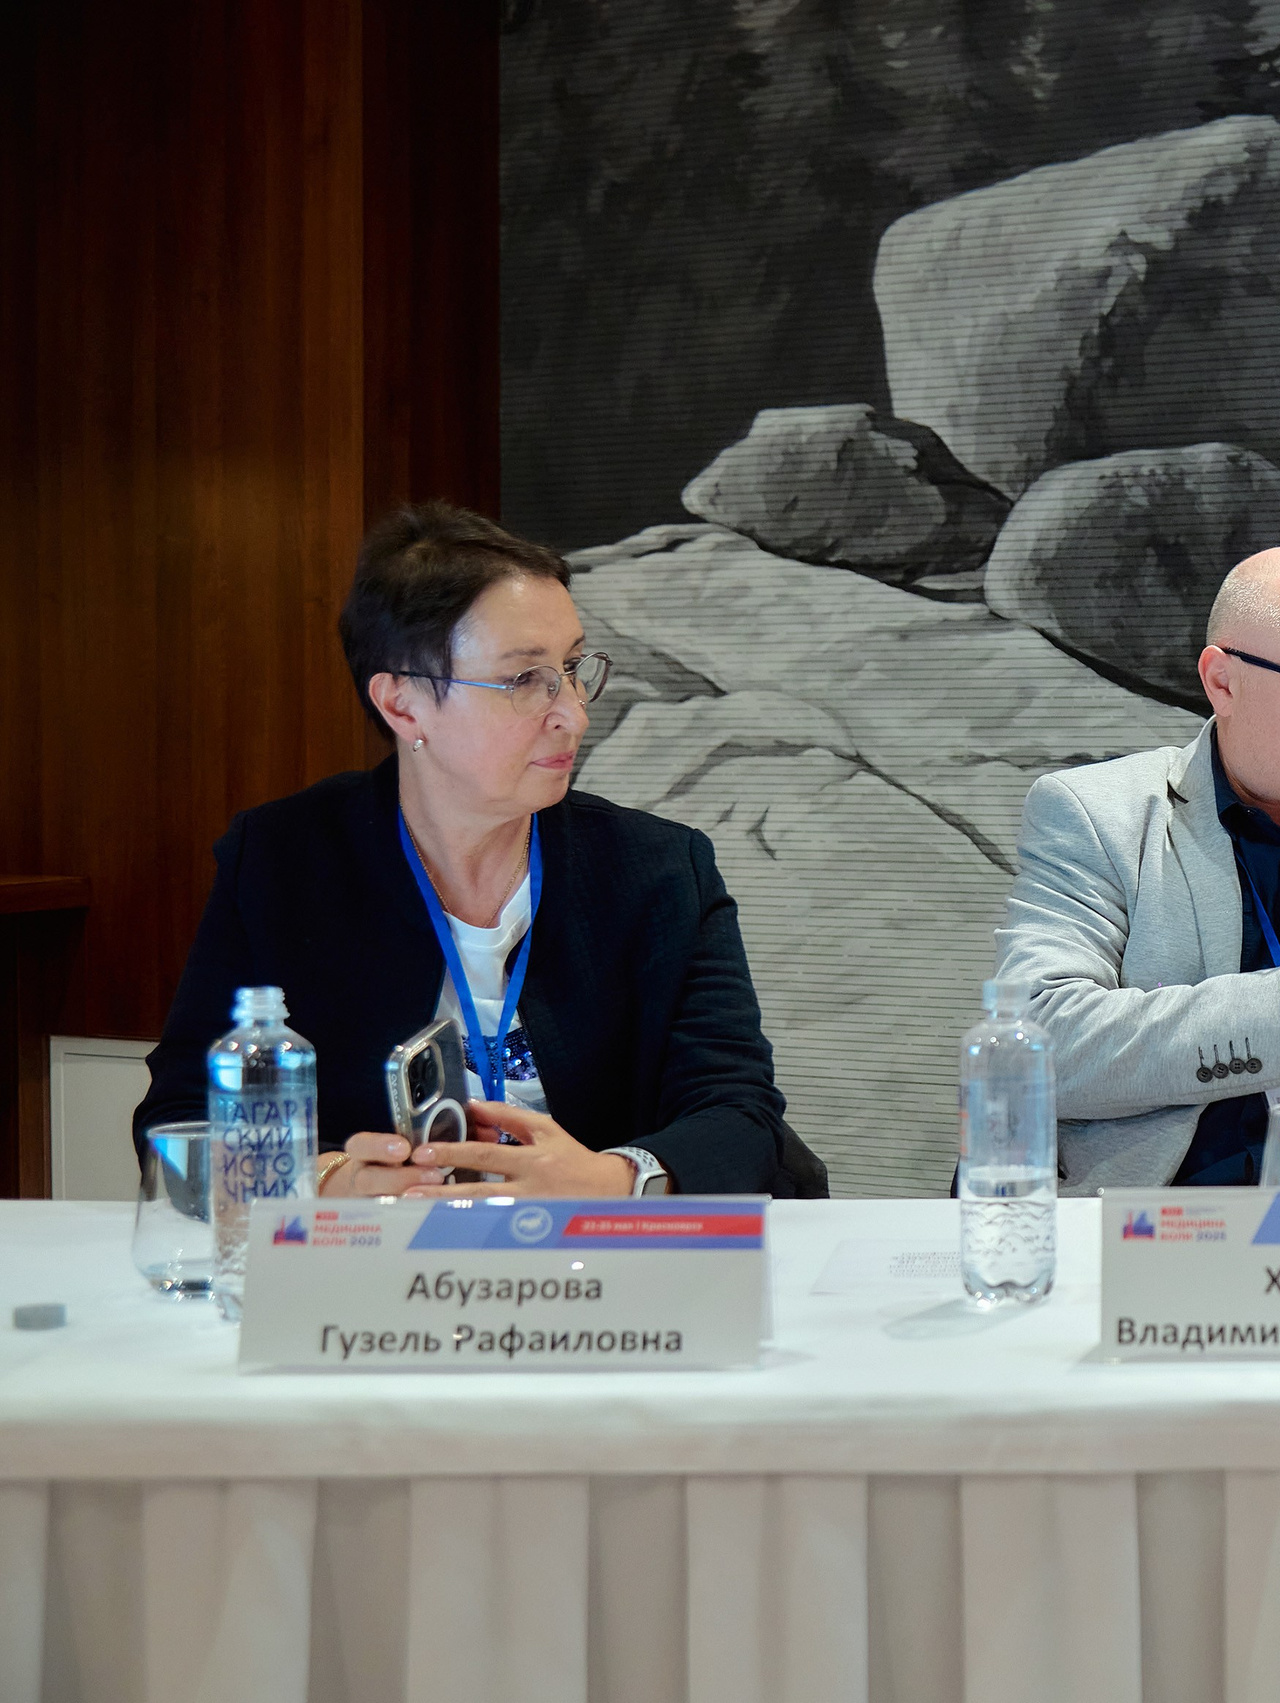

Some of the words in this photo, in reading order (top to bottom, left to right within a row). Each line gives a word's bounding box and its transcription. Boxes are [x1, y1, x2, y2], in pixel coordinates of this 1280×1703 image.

[223, 1152, 295, 1178] ИСТО
[406, 1270, 603, 1307] Абузарова
[320, 1323, 442, 1361] Гузель
[453, 1323, 683, 1361] Рафаиловна
